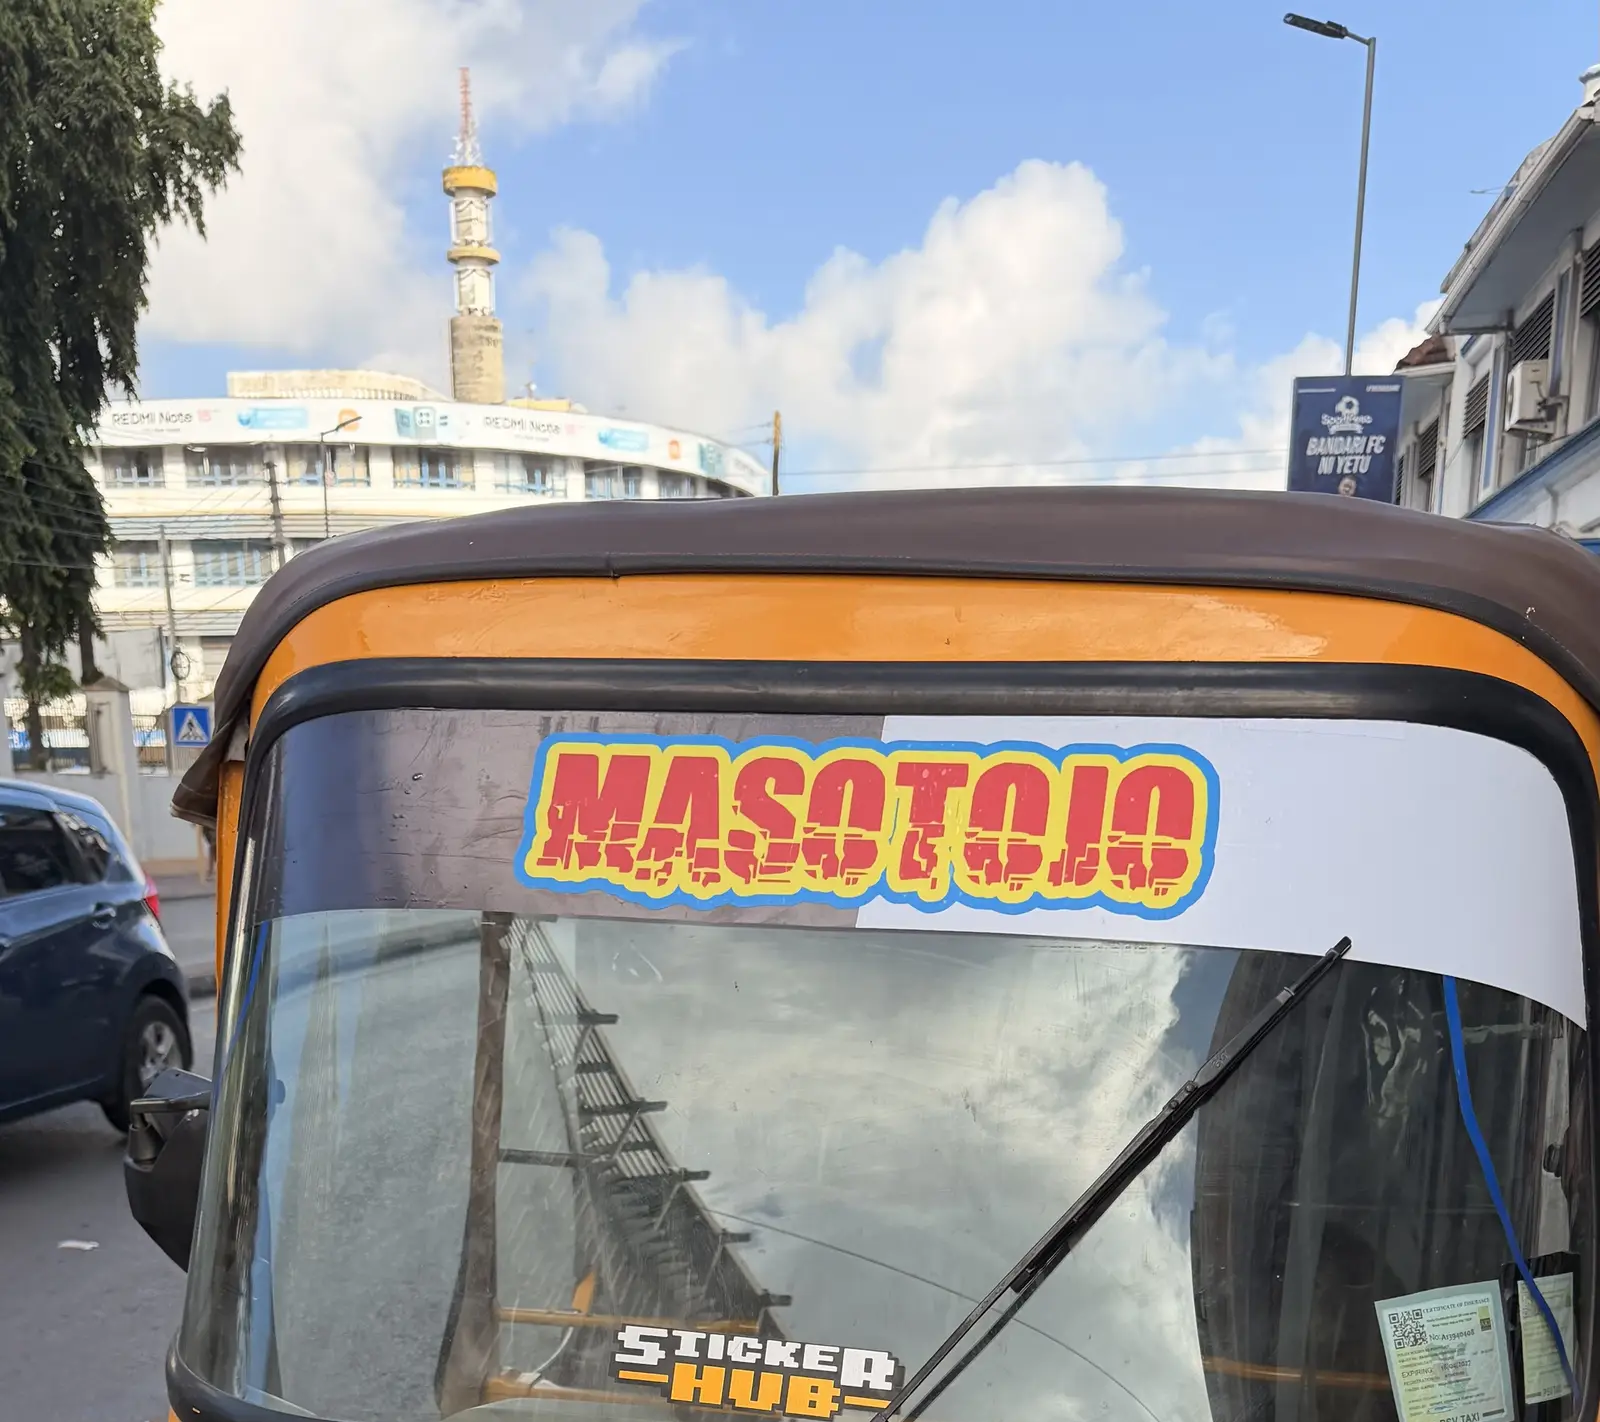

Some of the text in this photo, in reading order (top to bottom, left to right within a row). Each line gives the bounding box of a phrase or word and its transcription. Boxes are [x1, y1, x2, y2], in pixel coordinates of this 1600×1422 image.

[1305, 434, 1386, 456] BANDARI FC
[1318, 455, 1372, 475] NI YETU
[533, 750, 1198, 897] MASOTOJO
[614, 1325, 895, 1391] STICKER
[670, 1361, 842, 1419] HUB
